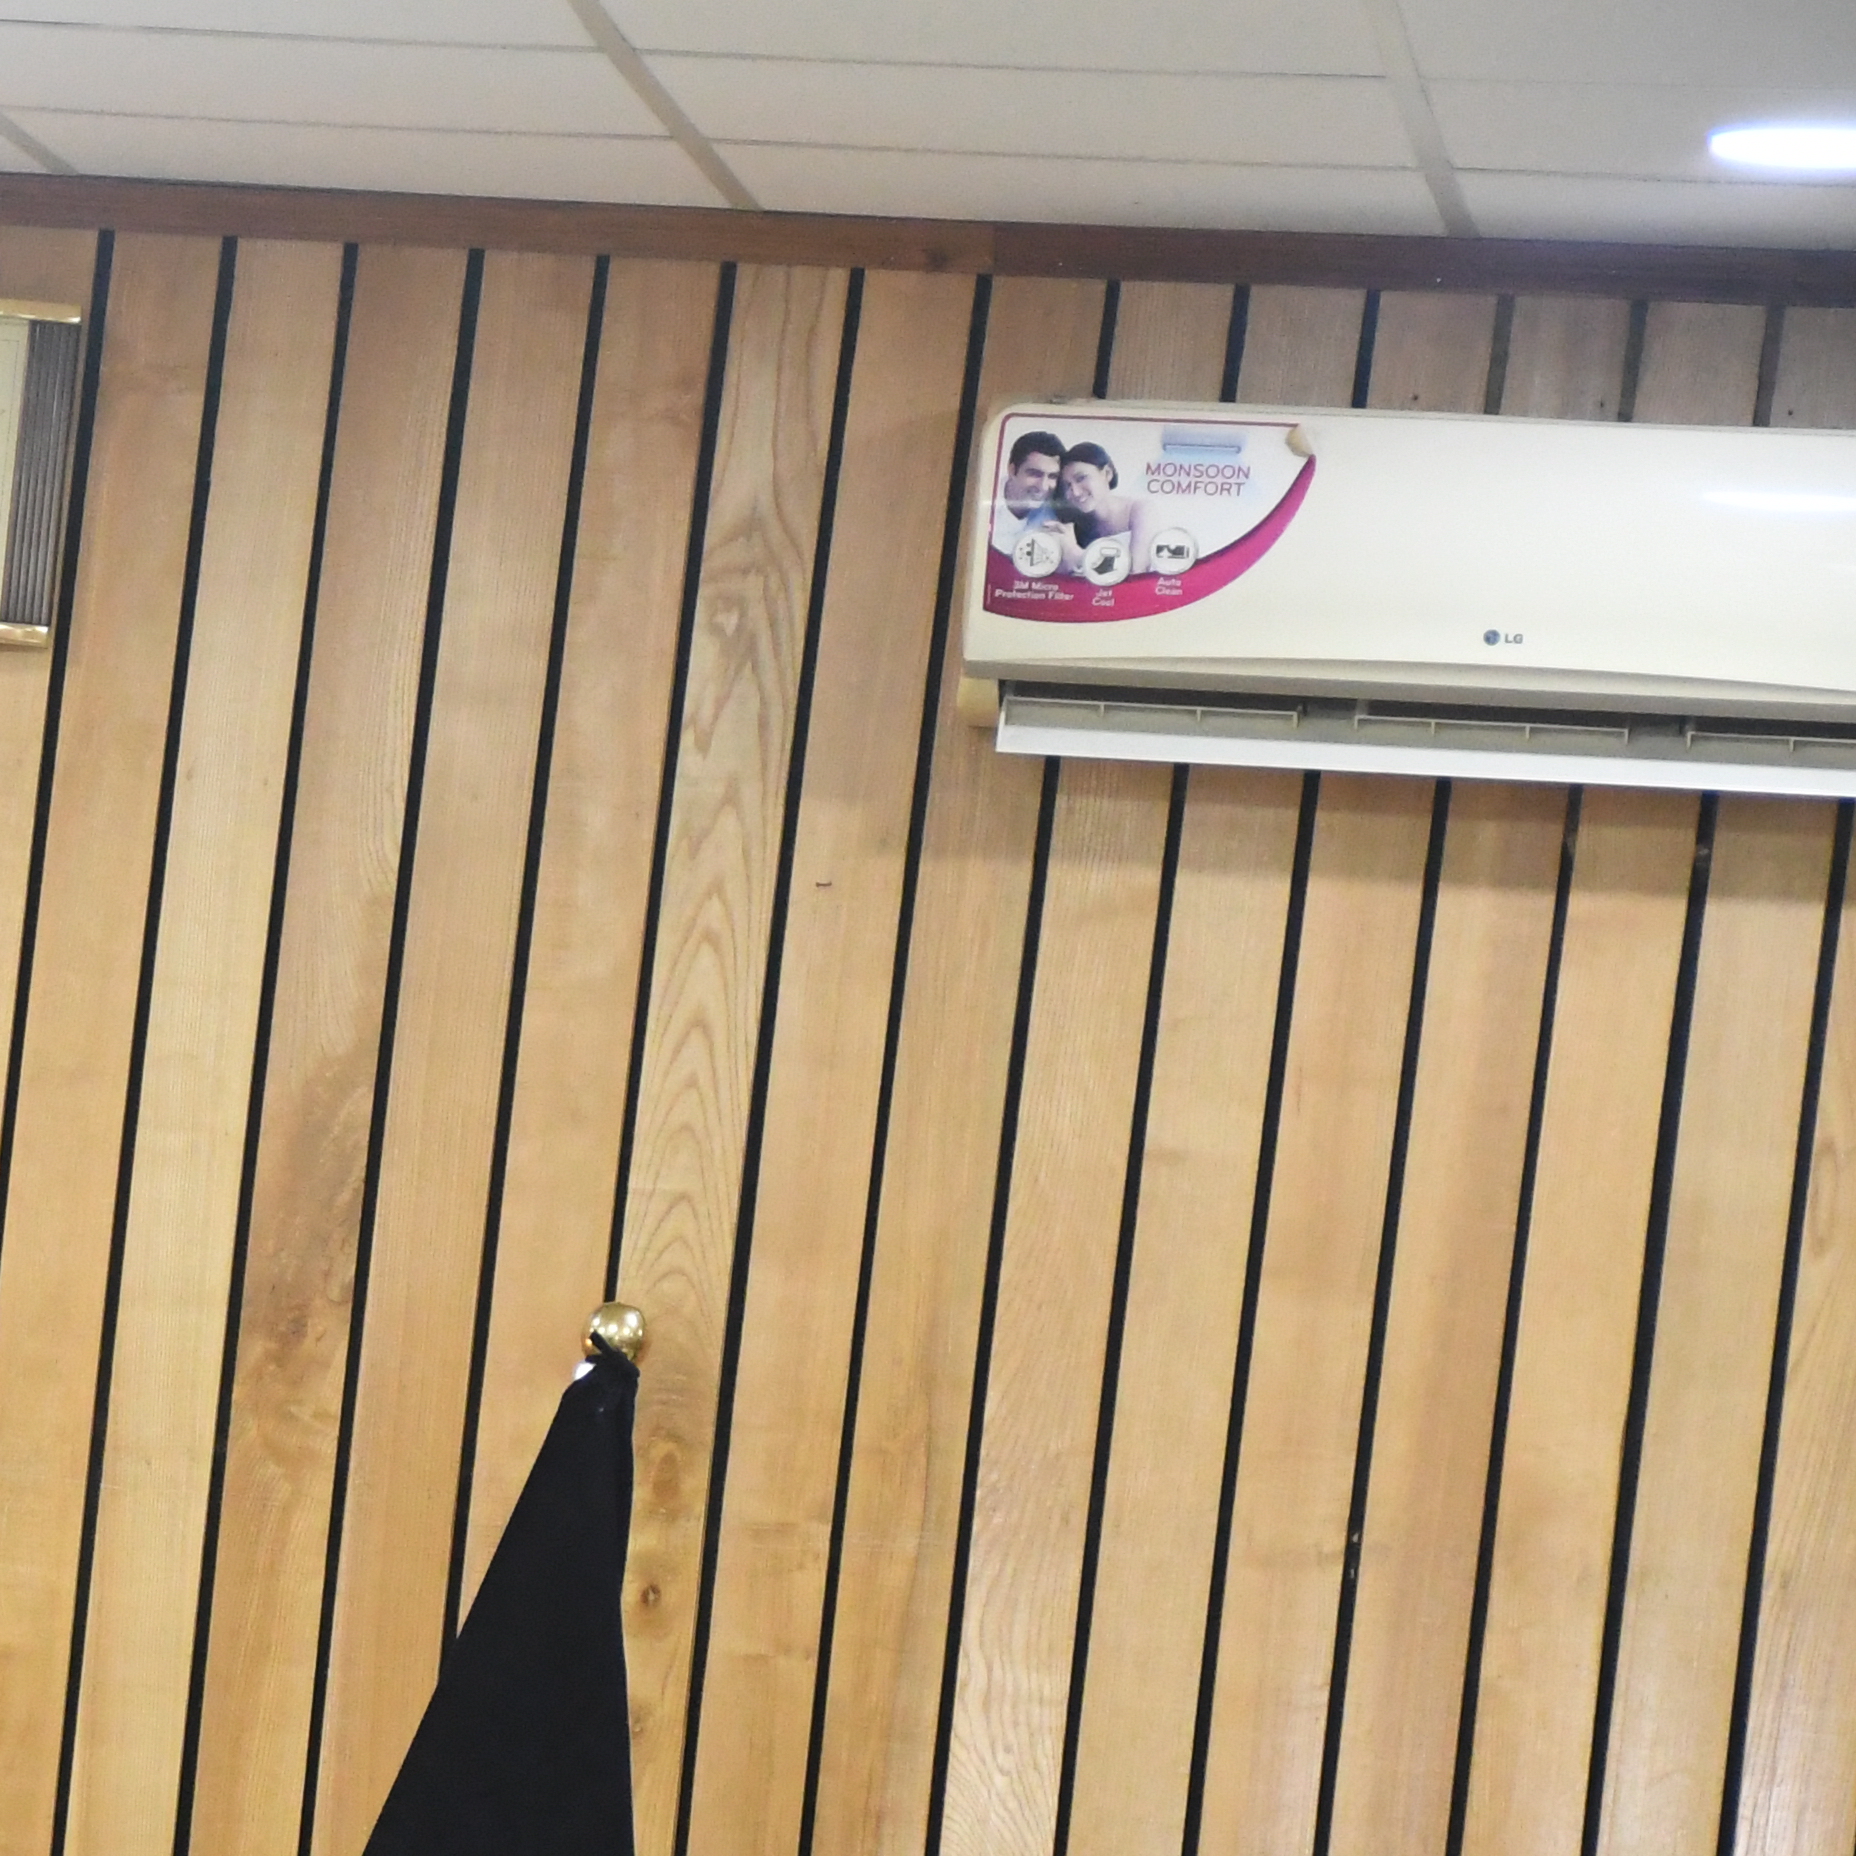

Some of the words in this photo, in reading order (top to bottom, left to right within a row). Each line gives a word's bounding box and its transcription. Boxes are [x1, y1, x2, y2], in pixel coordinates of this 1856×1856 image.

[1145, 462, 1252, 480] MONSOON
[1146, 479, 1246, 497] COMFORT
[1031, 581, 1059, 592] Micro
[1157, 577, 1182, 588] Auto
[1048, 590, 1074, 601] Filter
[1155, 586, 1183, 597] Clean
[1504, 633, 1524, 644] LG
